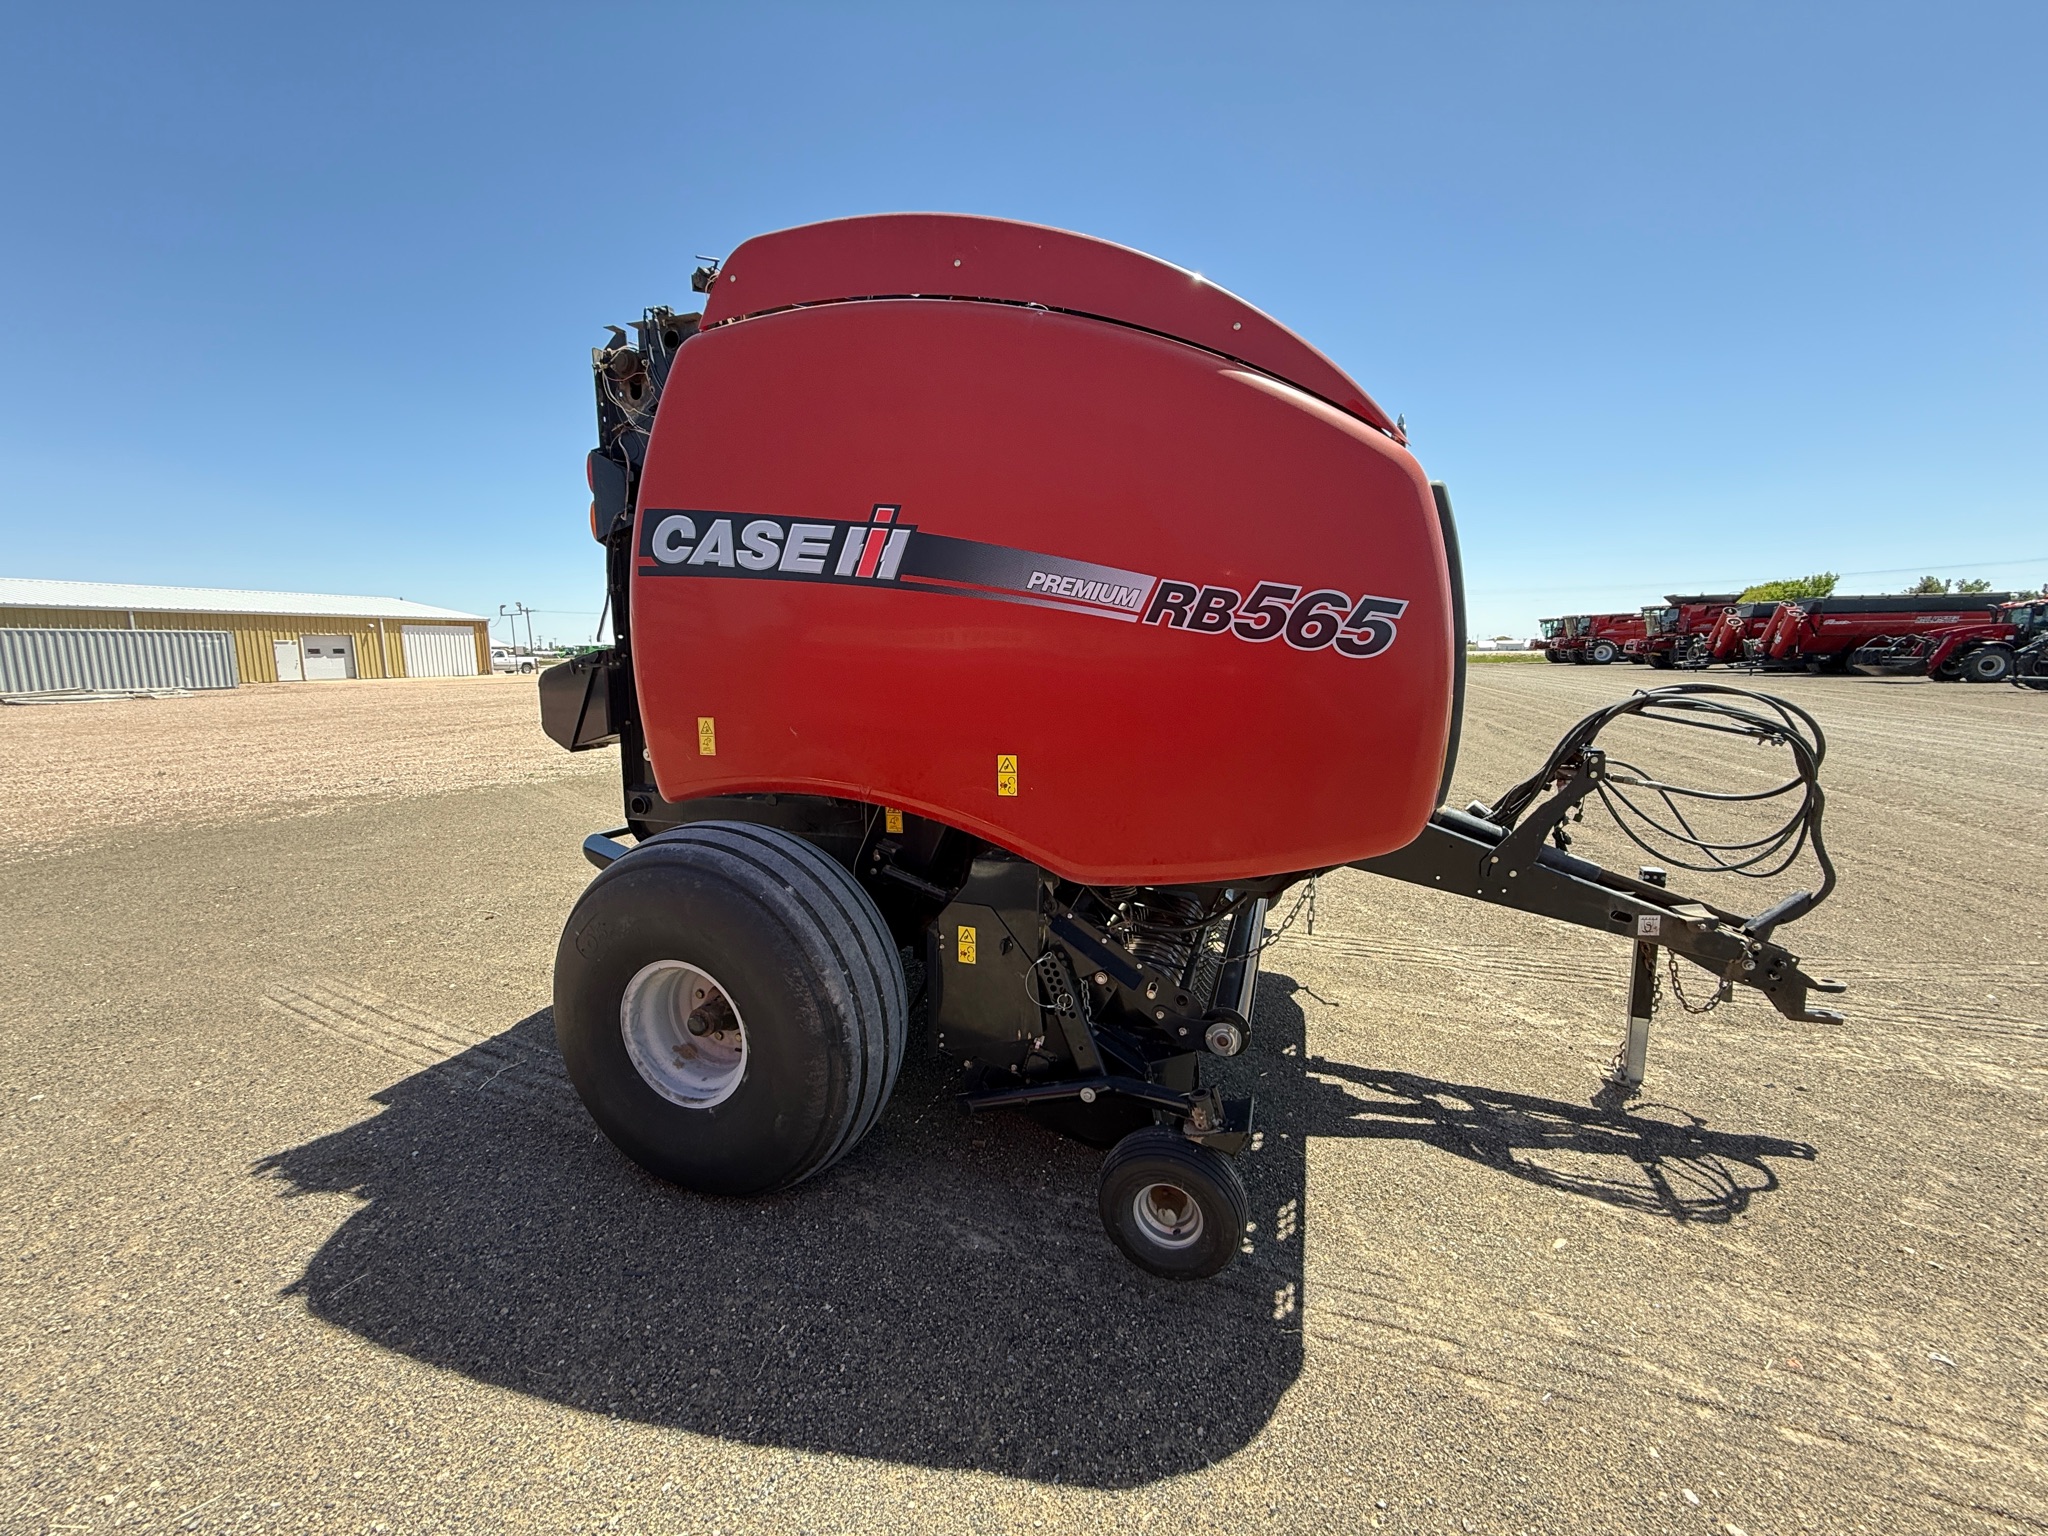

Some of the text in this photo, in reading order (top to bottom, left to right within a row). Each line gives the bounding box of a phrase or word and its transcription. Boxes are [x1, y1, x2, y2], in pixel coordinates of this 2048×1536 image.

[651, 513, 836, 575] CASE
[1026, 571, 1410, 660] PREMIUM RB565
